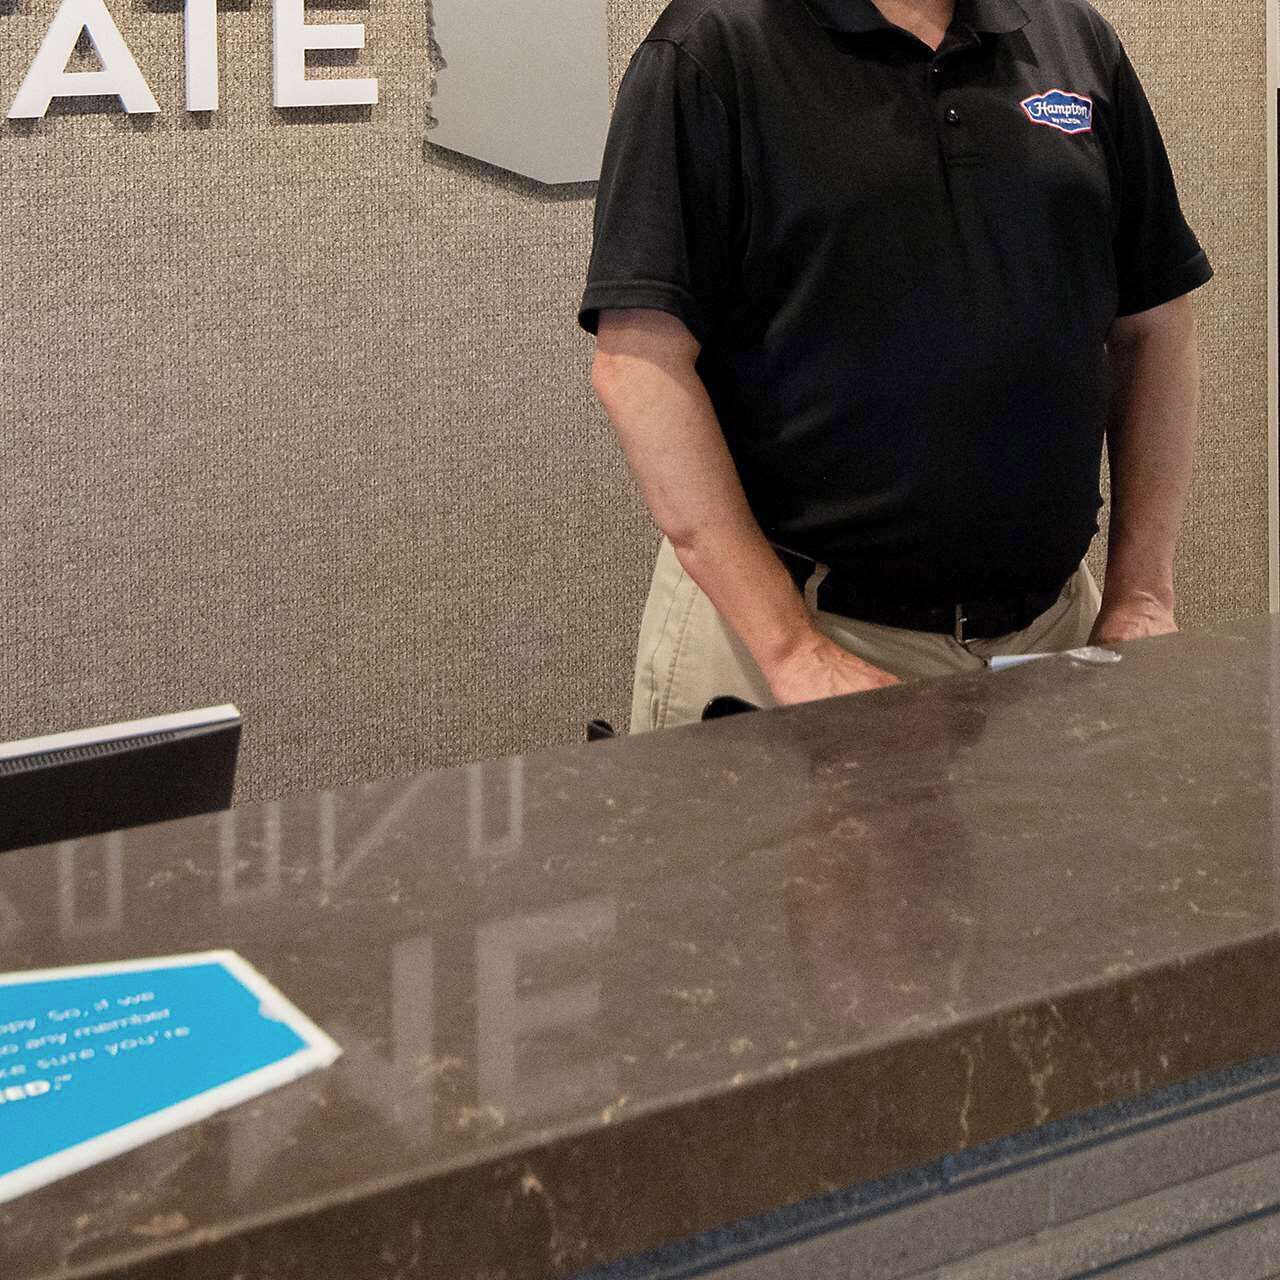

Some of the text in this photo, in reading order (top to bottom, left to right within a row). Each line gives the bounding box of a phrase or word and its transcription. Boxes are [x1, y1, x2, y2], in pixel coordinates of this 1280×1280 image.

[1028, 102, 1089, 120] Hampton
[117, 991, 155, 1006] we
[25, 1032, 68, 1051] any
[73, 1008, 170, 1039] member
[36, 1047, 95, 1070] sure
[104, 1026, 191, 1057] you're
